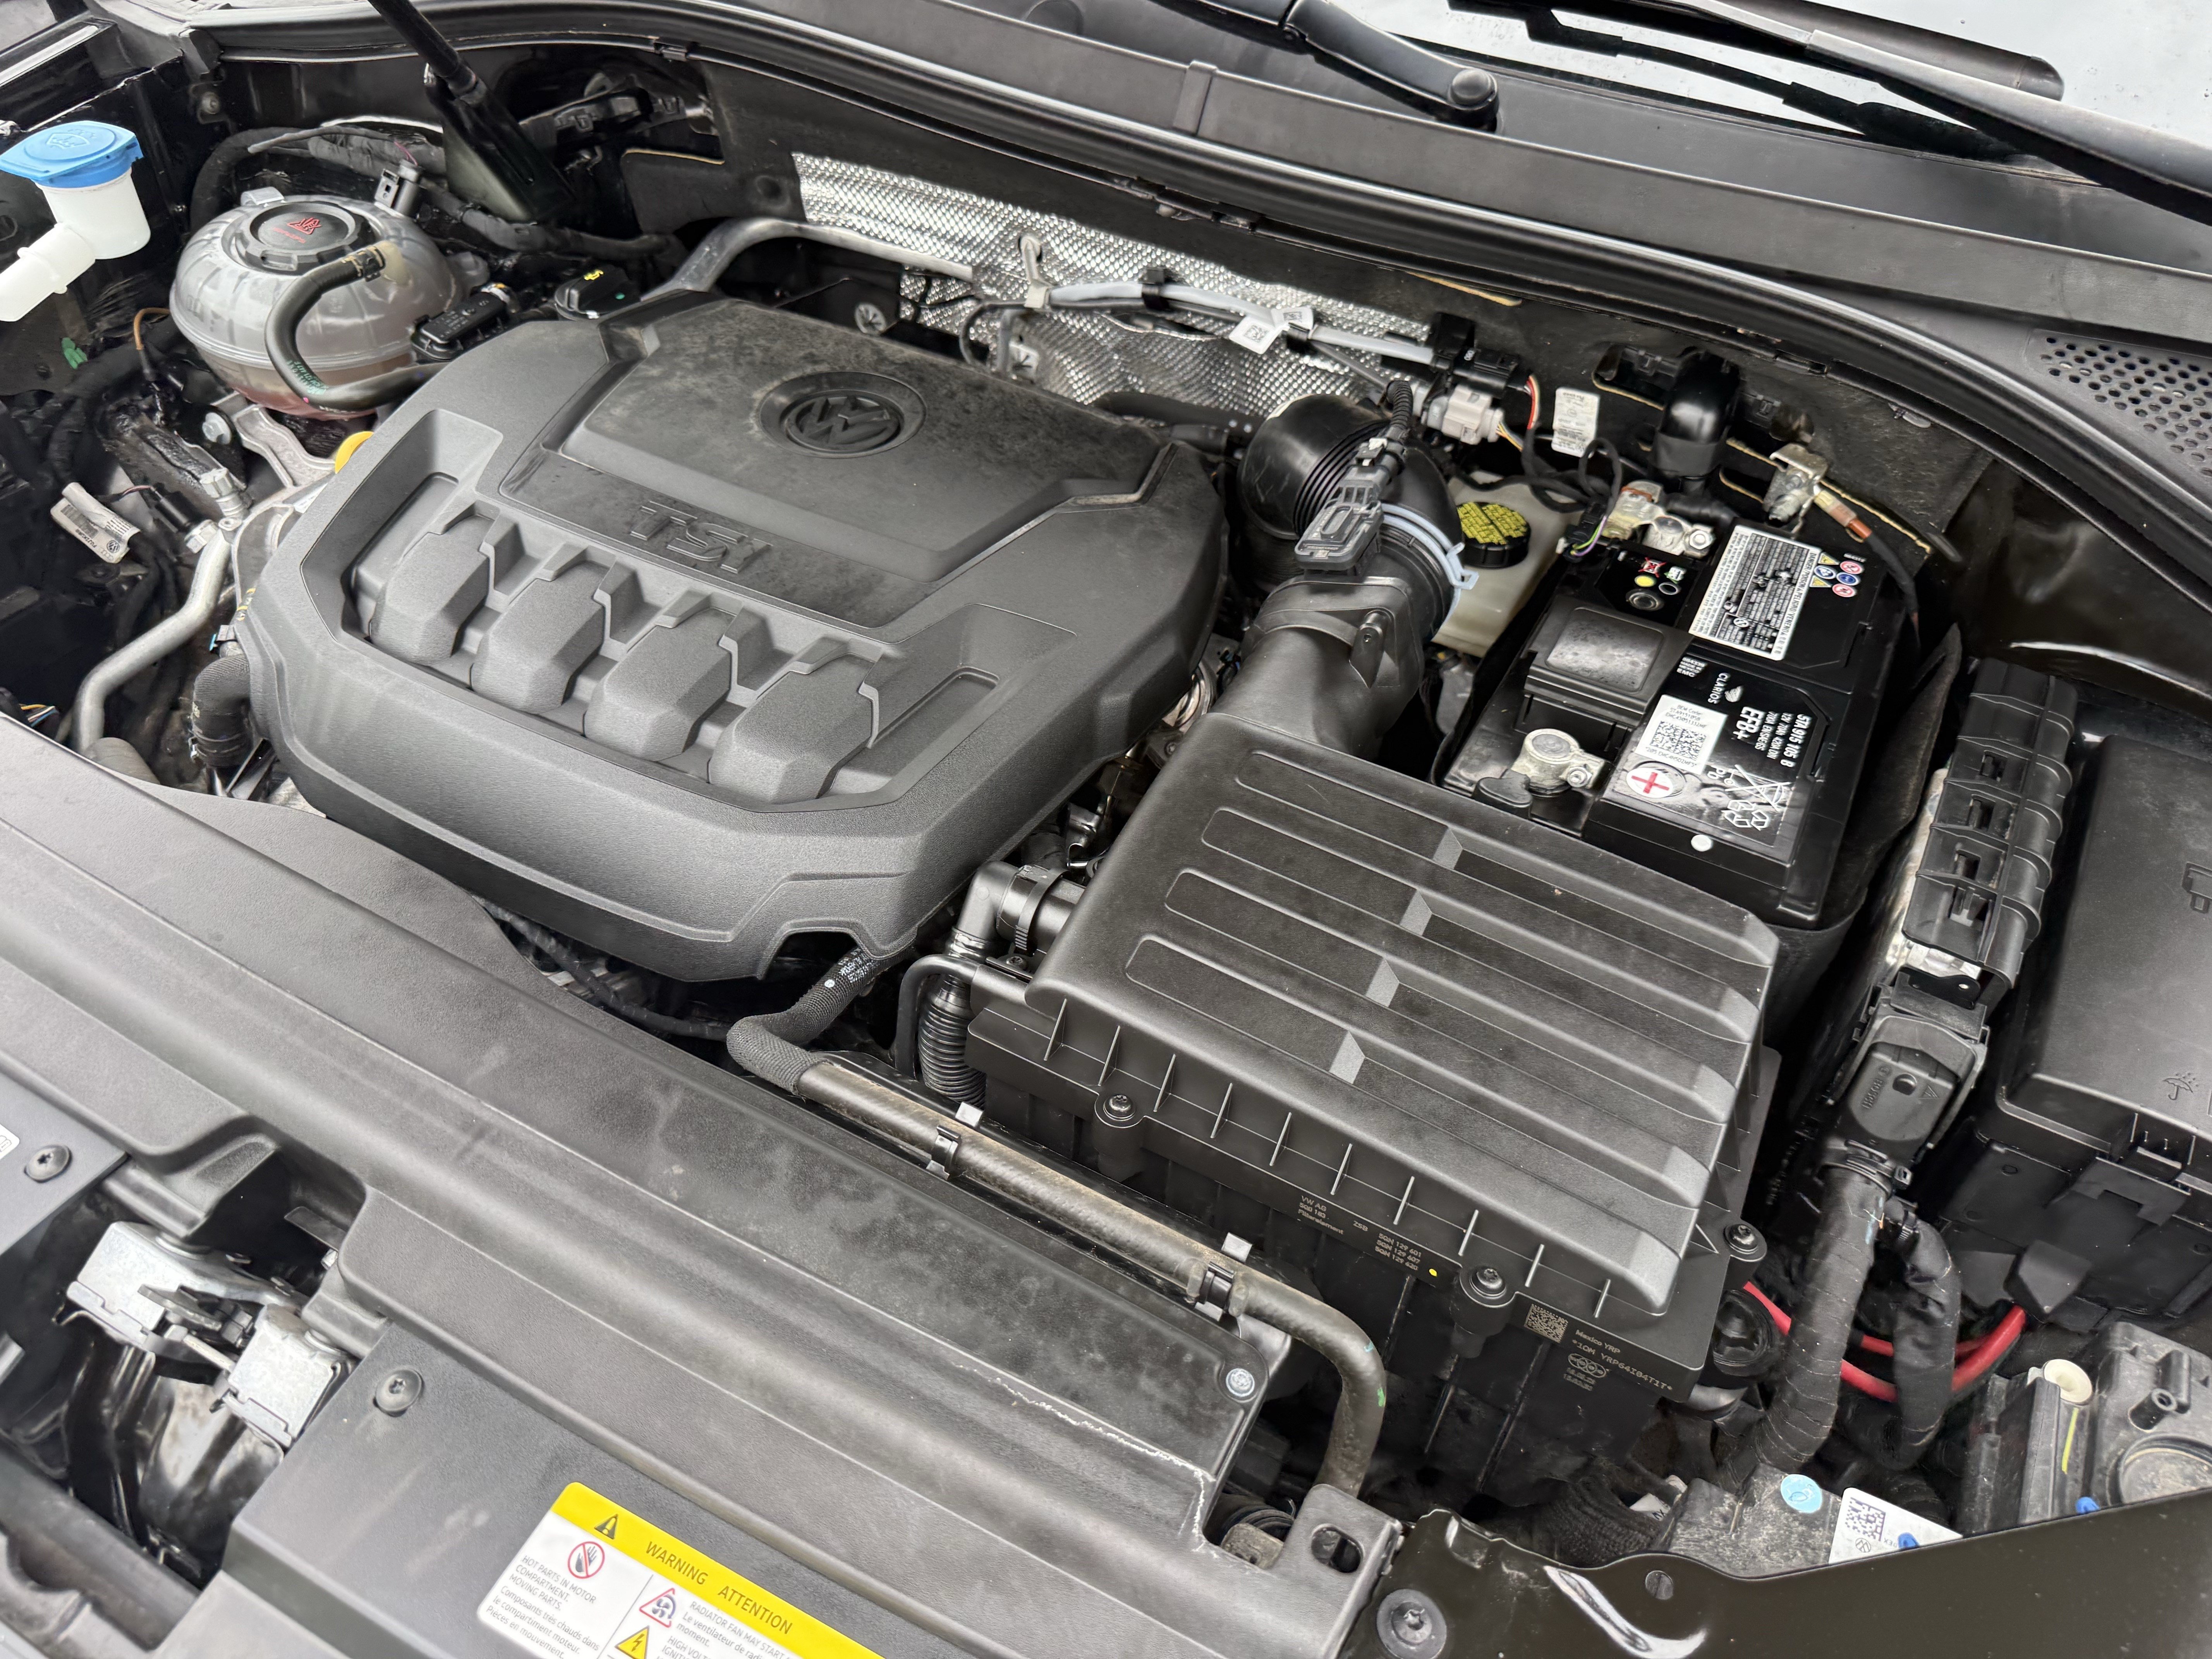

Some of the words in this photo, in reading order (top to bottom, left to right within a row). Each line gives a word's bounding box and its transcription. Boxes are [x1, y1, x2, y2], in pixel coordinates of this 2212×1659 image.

[630, 501, 773, 574] TSI
[1707, 673, 1729, 704] CLARIOS
[1731, 706, 1764, 740] EFB+
[1764, 711, 1779, 725] 700A
[1781, 713, 1793, 723] 12V
[1793, 714, 1811, 729] 5TA
[1775, 723, 1789, 736] 70Ah
[1789, 728, 1806, 744] 915
[1769, 737, 1784, 750] 420A
[1783, 744, 1801, 759] 105
[1766, 749, 1780, 759] DIN
[1780, 759, 1795, 768] B
[1707, 765, 1728, 780] Pb
[1301, 1195, 1314, 1205] VW
[1314, 1203, 1327, 1212] AG
[1353, 1220, 1368, 1231] ZSB
[1394, 1248, 1407, 1257] 129
[1396, 1241, 1408, 1251] 129
[1409, 1249, 1422, 1257] 601
[1392, 1254, 1404, 1264] 129
[1575, 1329, 1602, 1346] Mexico
[1604, 1343, 1621, 1353] YRP
[515, 1564, 570, 1602] COMPARTMENT.
[522, 1555, 539, 1568] HOT
[537, 1564, 561, 1582] PARTS
[560, 1578, 570, 1588] IN
[568, 1583, 596, 1604] MOTOR
[509, 1573, 539, 1596] MOVING
[538, 1591, 562, 1611] PARTS.
[646, 1541, 709, 1585] WARNING
[717, 1585, 793, 1635] ATTENTION
[493, 1595, 501, 1605] le
[501, 1602, 552, 1637] compartiment
[552, 1633, 580, 1654] moteur.
[501, 1586, 543, 1616] Composants
[557, 1621, 582, 1640] chauds
[582, 1636, 600, 1651] dans
[509, 1622, 519, 1631] en
[677, 1623, 709, 1647] moment.
[682, 1612, 691, 1623] Le
[694, 1619, 735, 1646] ventilateur
[735, 1644, 745, 1654] de
[690, 1601, 728, 1628] RADIATOR
[727, 1623, 744, 1637] FAN
[744, 1633, 761, 1646] MAY
[760, 1643, 785, 1659] START
[668, 1636, 688, 1652] HIGH
